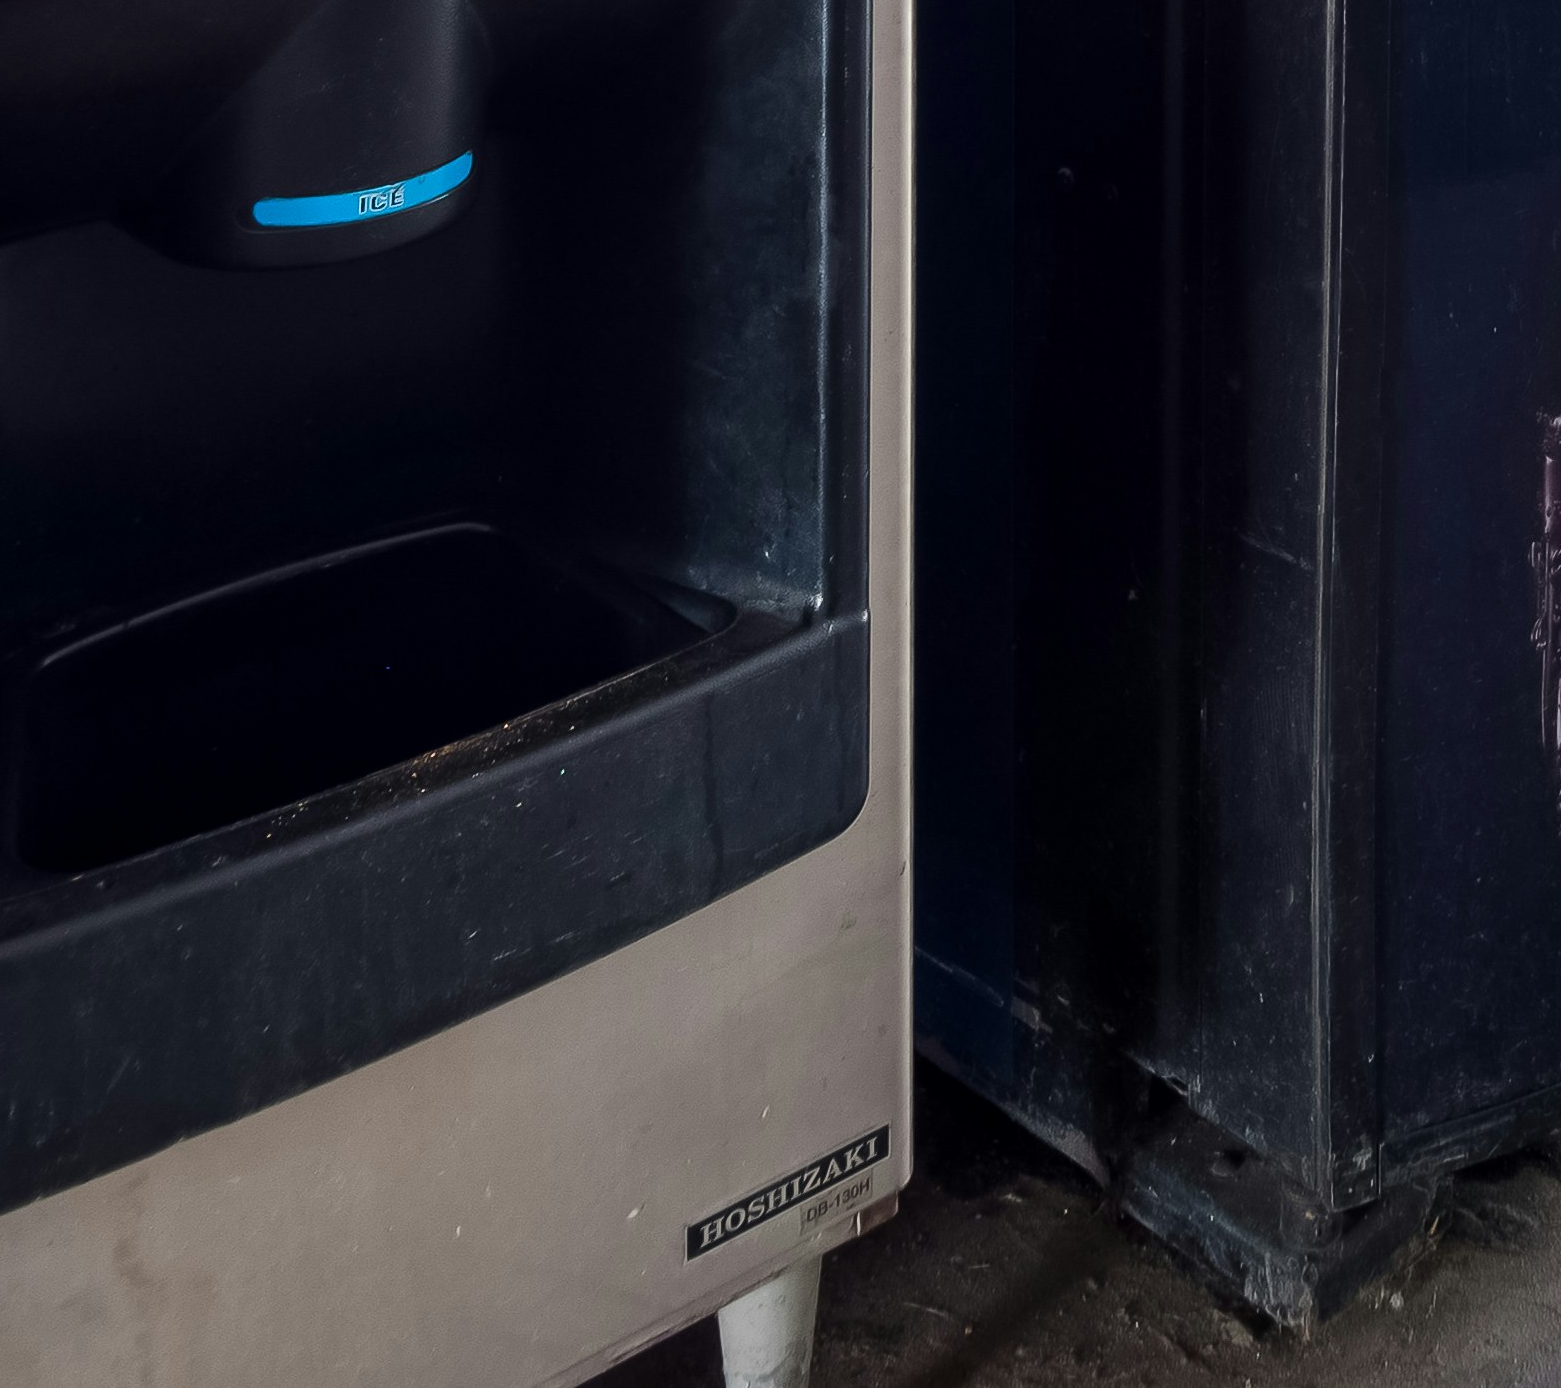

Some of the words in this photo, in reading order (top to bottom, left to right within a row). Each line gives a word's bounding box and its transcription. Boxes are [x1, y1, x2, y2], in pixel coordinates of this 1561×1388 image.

[358, 184, 406, 215] ICE
[699, 1135, 879, 1249] HOSHIZAKI
[806, 1176, 871, 1223] DB-130H
